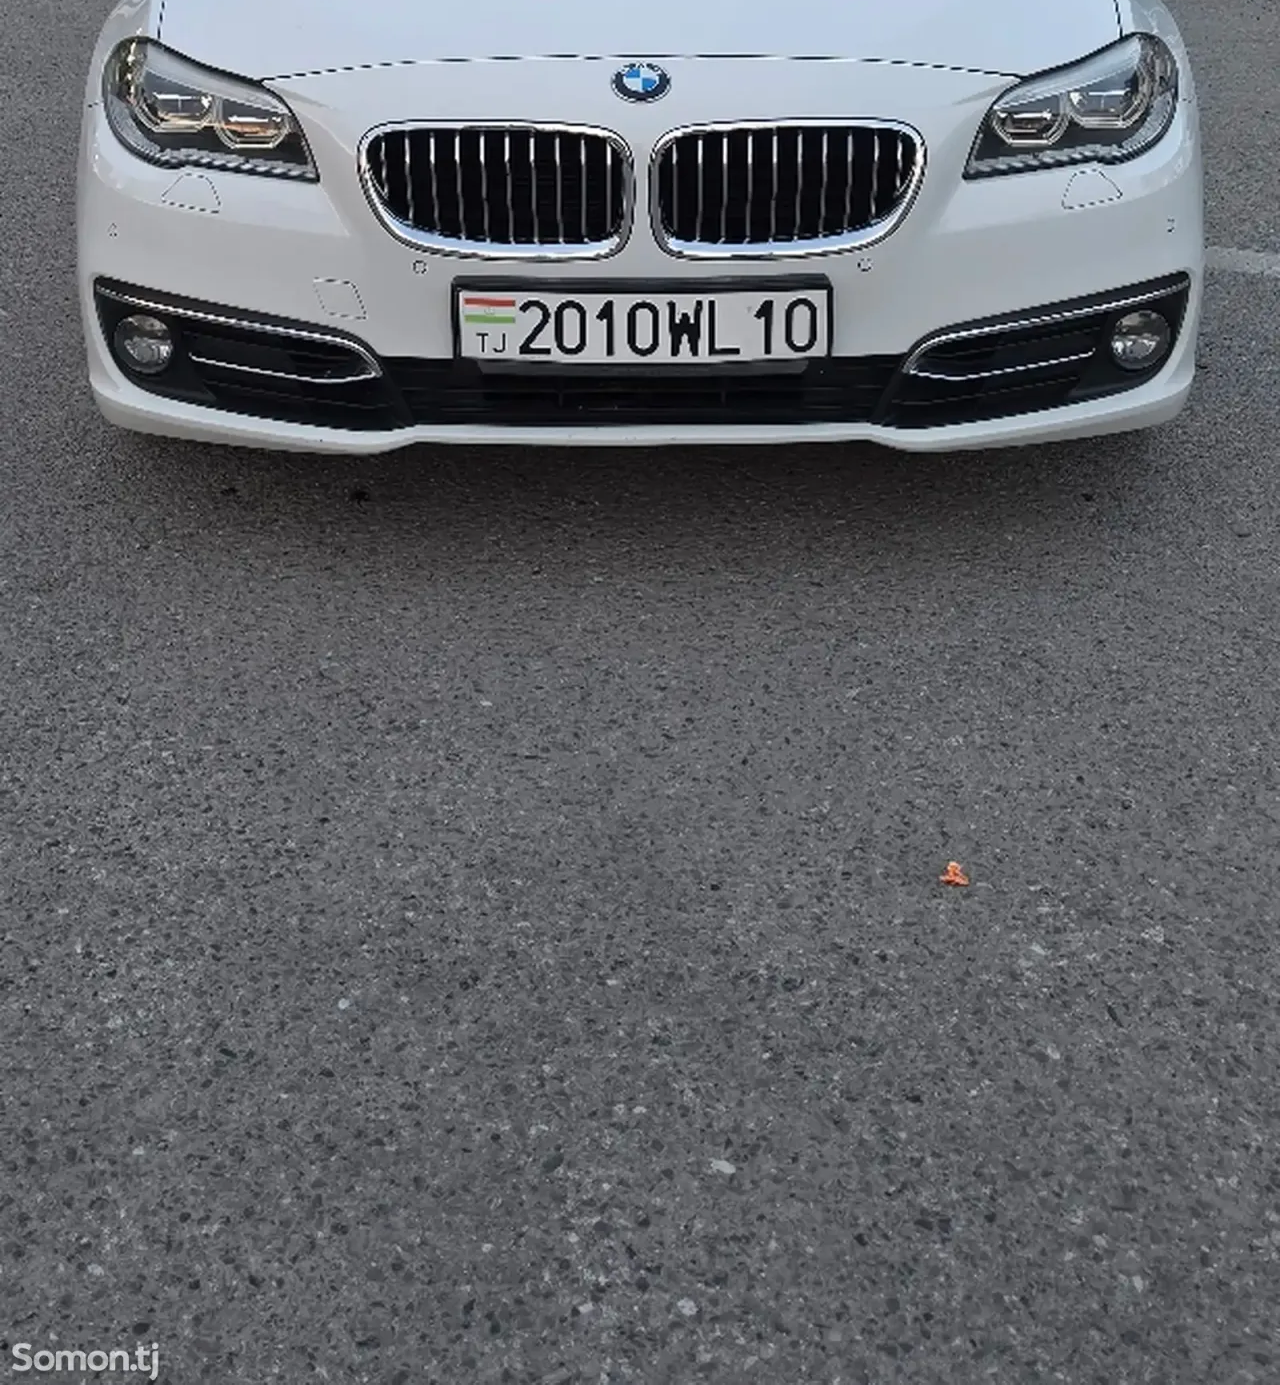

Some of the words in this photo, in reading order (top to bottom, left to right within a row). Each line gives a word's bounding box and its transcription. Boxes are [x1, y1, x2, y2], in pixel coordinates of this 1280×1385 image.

[475, 332, 507, 353] TJ
[518, 299, 741, 357] 2010WL
[753, 297, 818, 356] 10
